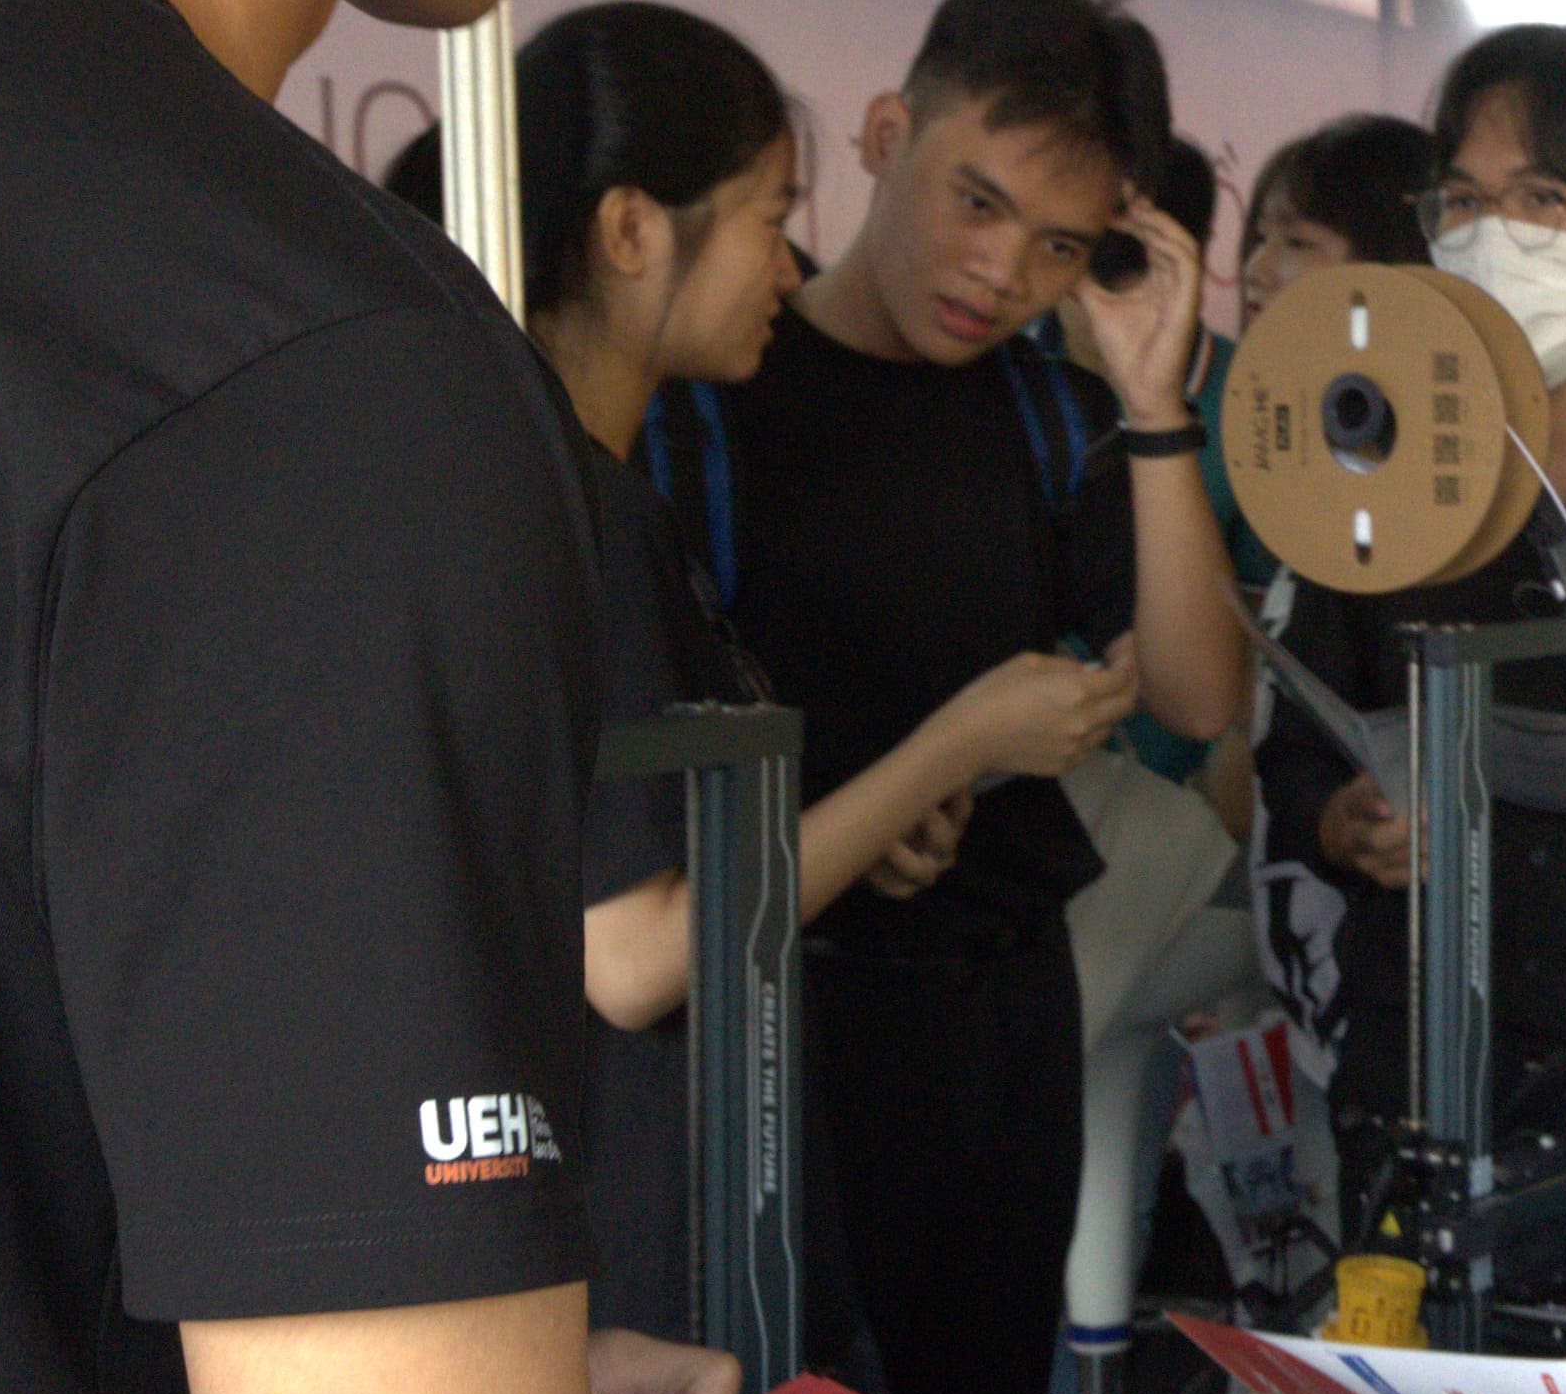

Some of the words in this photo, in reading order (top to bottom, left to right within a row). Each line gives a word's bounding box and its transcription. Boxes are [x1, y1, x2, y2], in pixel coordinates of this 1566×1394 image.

[762, 1065, 777, 1106] THE
[418, 1092, 528, 1162] UEH
[424, 1155, 530, 1186] UNIVERSITY
